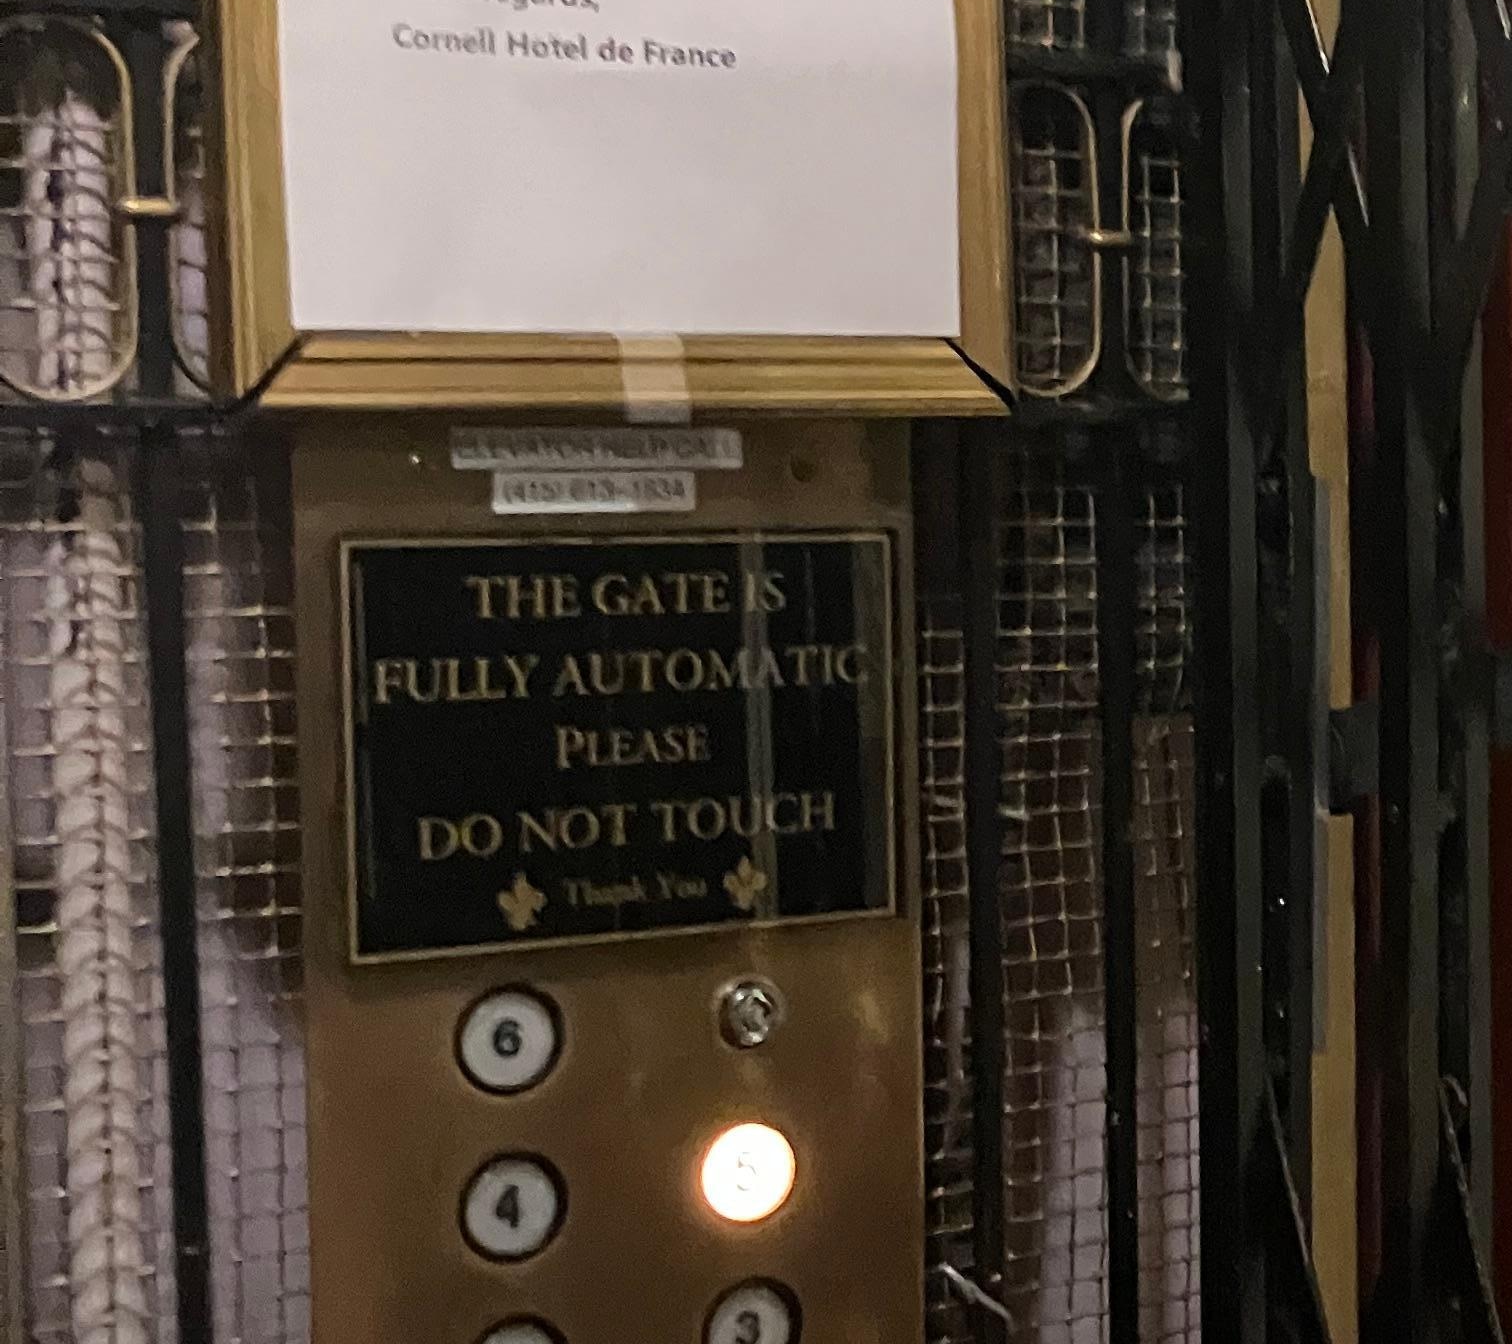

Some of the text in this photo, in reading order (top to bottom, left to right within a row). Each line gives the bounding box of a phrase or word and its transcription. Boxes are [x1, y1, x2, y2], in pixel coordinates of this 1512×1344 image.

[393, 22, 736, 69] Cornell Hotel de France
[464, 570, 786, 619] THE GATE IS
[374, 643, 869, 705] FULLY AUTOMATIC
[555, 725, 711, 770] PLEASE
[418, 791, 835, 861] DO NOT TOUCH
[563, 871, 707, 906] Thank You
[494, 1020, 521, 1057] 6
[495, 1185, 520, 1229] 4
